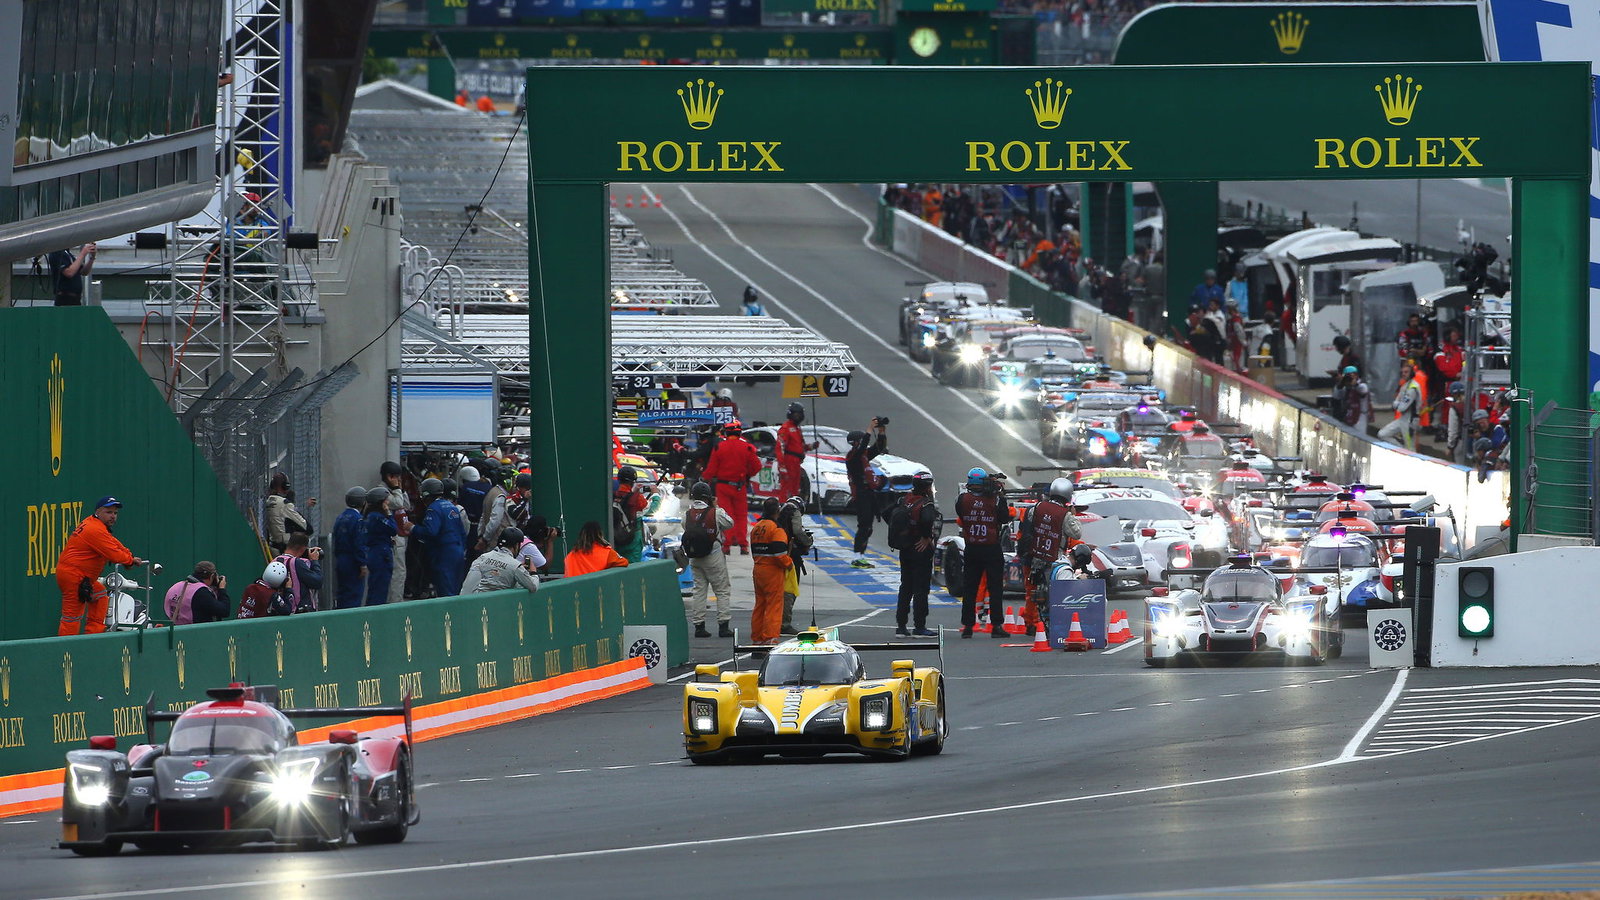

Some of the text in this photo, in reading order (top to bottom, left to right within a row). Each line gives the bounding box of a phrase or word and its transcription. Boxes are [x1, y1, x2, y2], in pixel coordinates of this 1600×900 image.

[623, 48, 665, 58] ROLEX
[617, 140, 784, 172] ROLEX
[965, 139, 1133, 172] ROLEX
[1314, 136, 1483, 169] ROLEX
[634, 377, 650, 388] 32
[830, 377, 848, 393] 29
[640, 408, 712, 419] ALGARVE PRO
[715, 411, 733, 424] 25
[1102, 489, 1153, 499] JMW
[969, 524, 988, 538] 479
[1061, 593, 1104, 604] WEC
[439, 666, 461, 695] ROLEX
[476, 660, 498, 689] ROLEX
[314, 683, 340, 708] ROLEX
[357, 678, 382, 707] ROLEX
[53, 711, 88, 743] ROLEX
[113, 705, 146, 738] ROLEX
